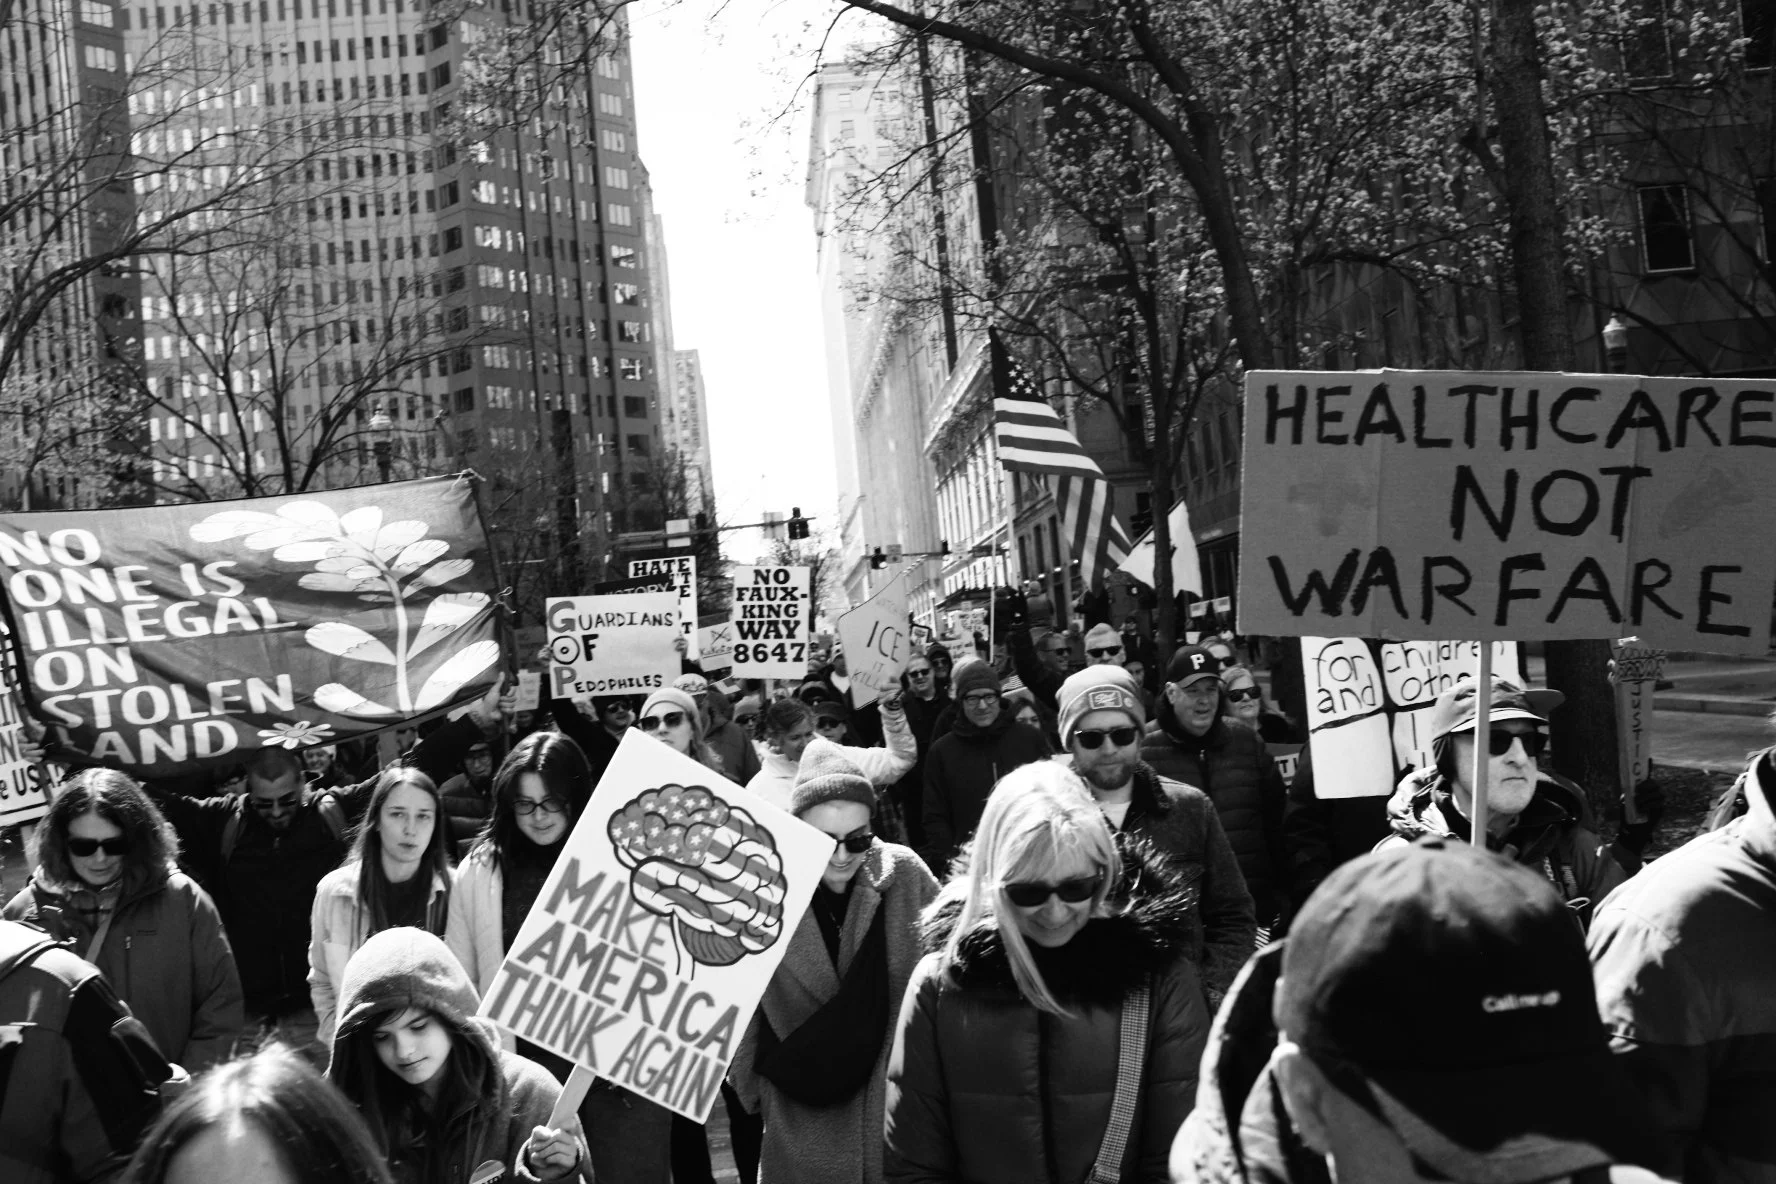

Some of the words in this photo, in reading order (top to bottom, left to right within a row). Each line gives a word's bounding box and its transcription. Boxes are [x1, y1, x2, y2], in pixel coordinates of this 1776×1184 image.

[1265, 382, 1776, 452] HEALTHCARE
[1449, 465, 1653, 543] NOT
[0, 528, 101, 566] NO
[633, 557, 690, 577] HATE
[10, 566, 160, 608] ONE
[180, 560, 245, 598] IS
[736, 587, 808, 602] FAUX-
[754, 568, 790, 585] NO
[1266, 546, 1752, 637] WARFARE
[23, 597, 298, 651] ILLEGAL
[548, 600, 674, 634] GUARDIANS
[736, 620, 801, 641] WAY
[742, 604, 799, 618] KING
[551, 633, 599, 665] OF
[733, 642, 806, 663] 8647
[866, 620, 903, 663] ICE
[1190, 653, 1206, 670] P
[33, 646, 138, 692] ON
[554, 665, 663, 696] PEDOPHILES
[1312, 640, 1366, 688] for
[41, 673, 295, 729] STOLEN
[1316, 673, 1377, 714] and
[1631, 681, 1643, 785] JUSTIC
[543, 857, 673, 967] MAKE
[517, 920, 740, 1063] AMERICA
[488, 959, 626, 1070] THINK
[608, 1025, 727, 1119] AGAIN
